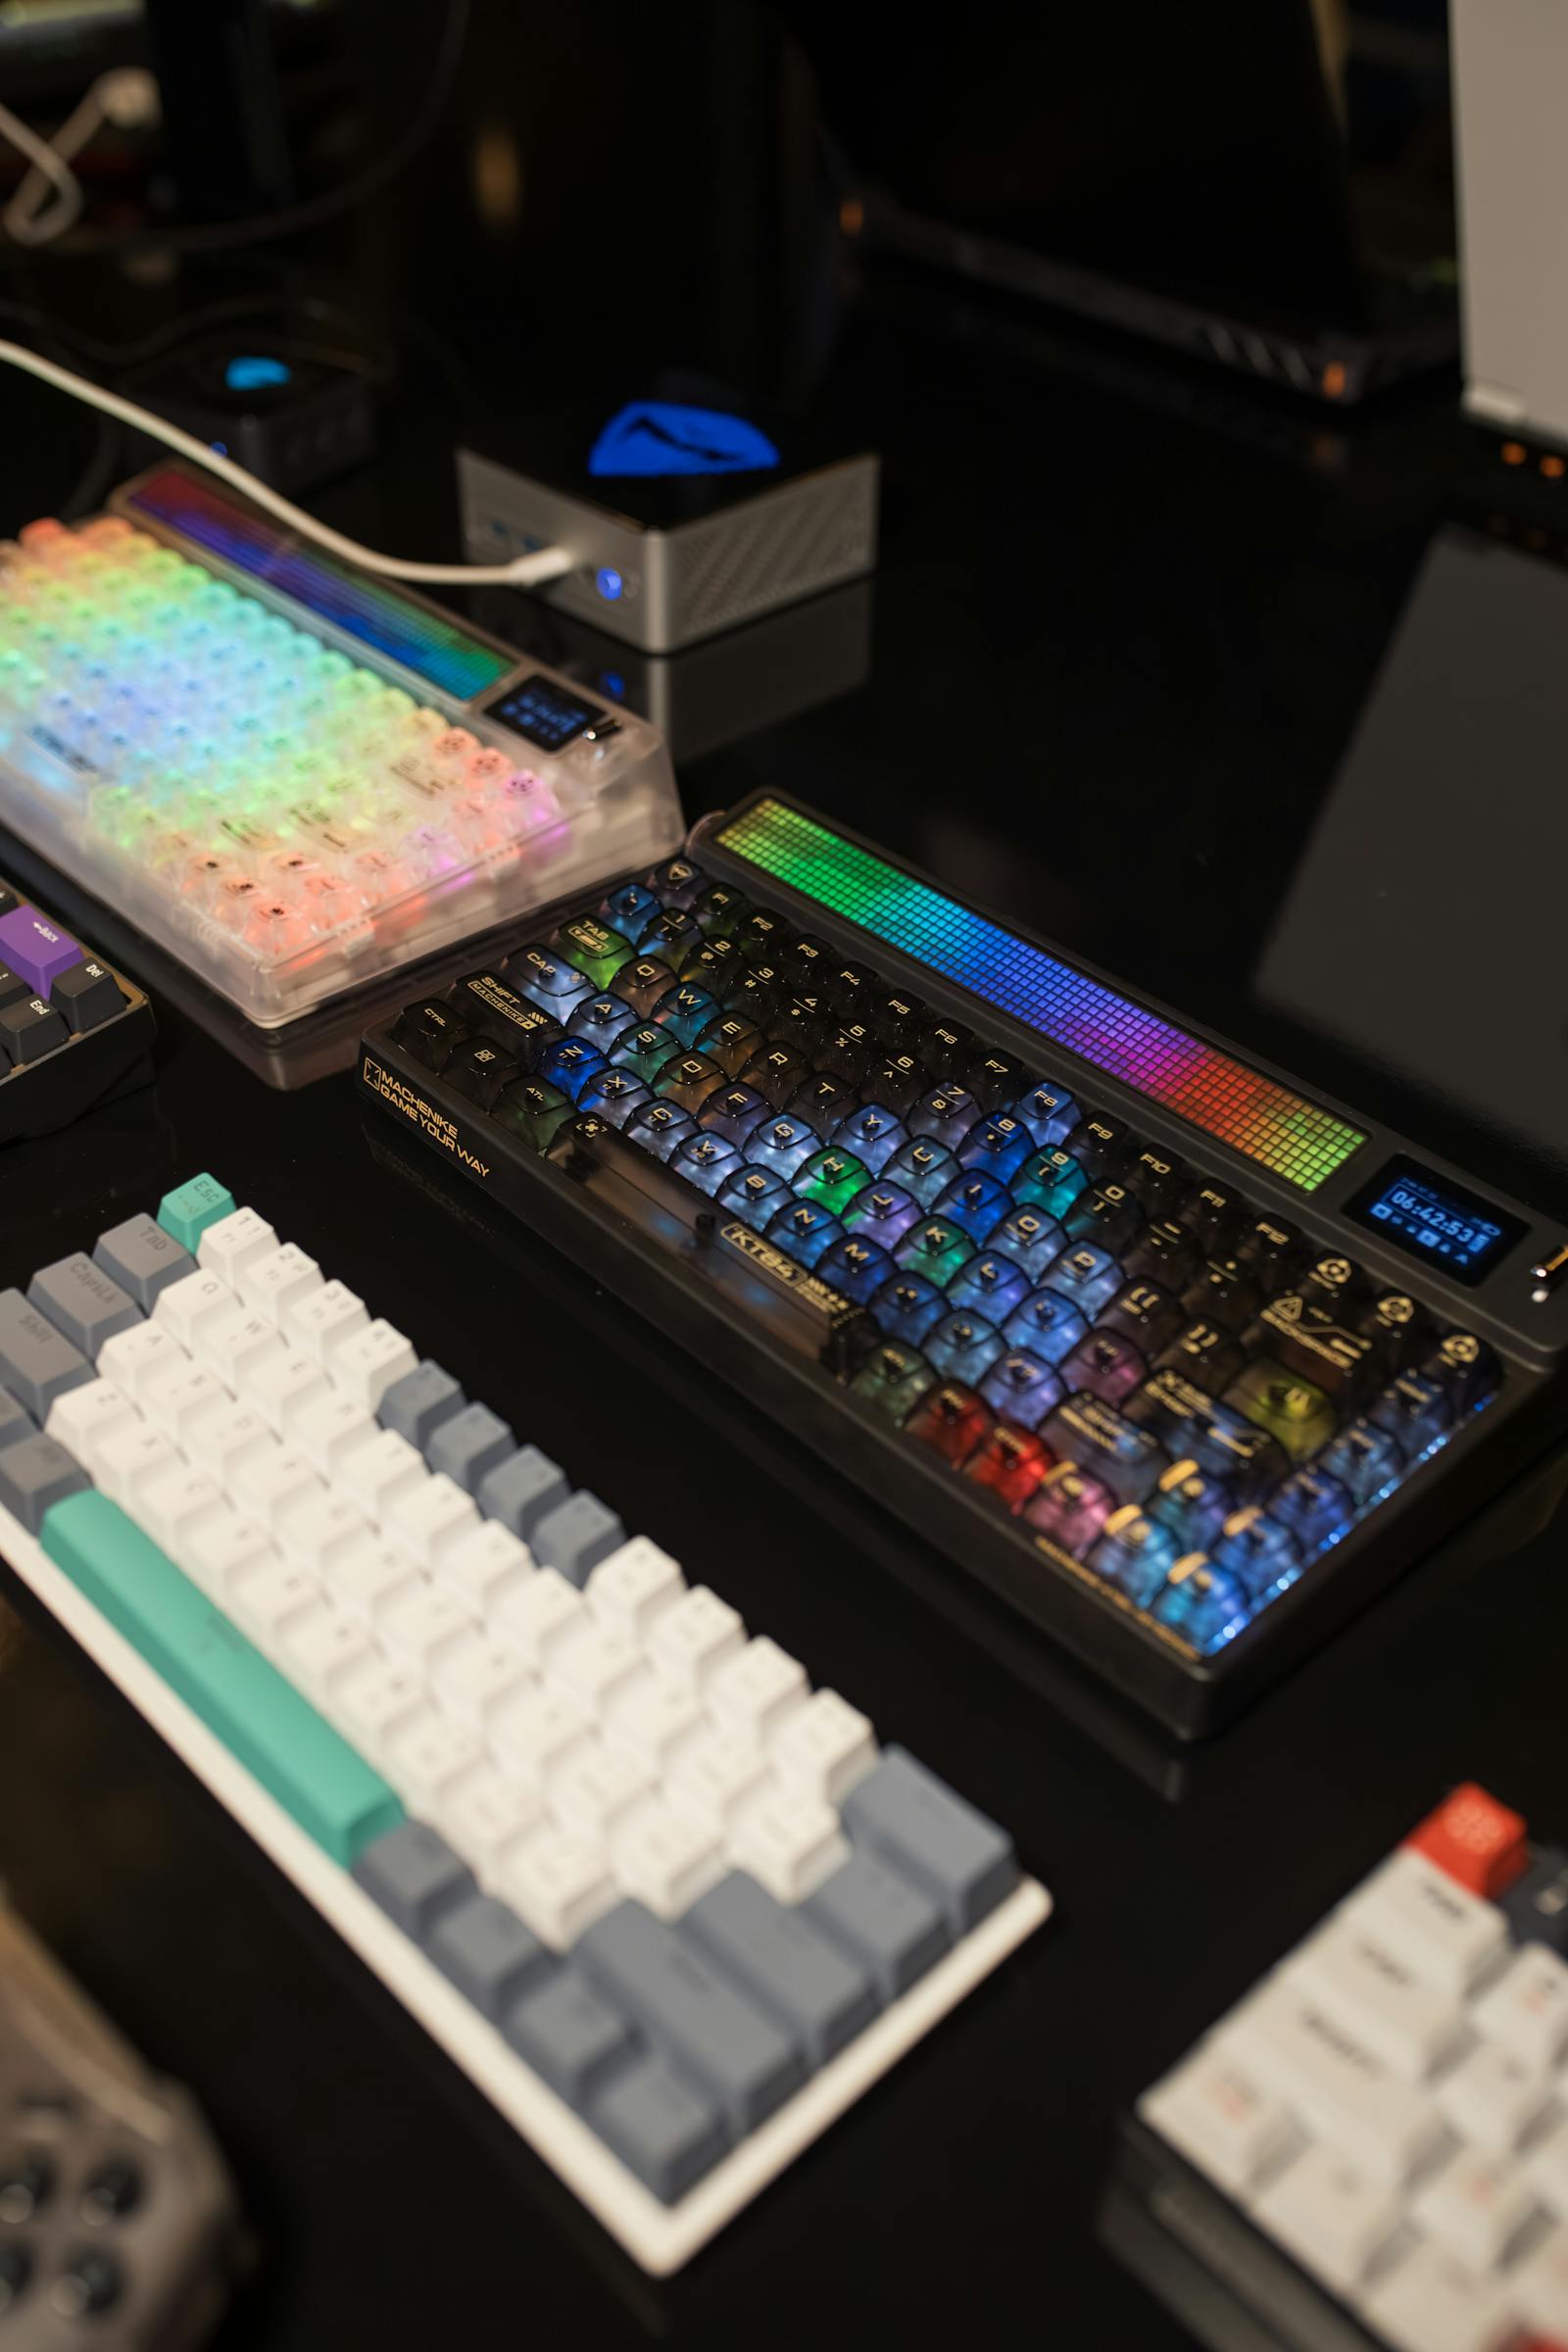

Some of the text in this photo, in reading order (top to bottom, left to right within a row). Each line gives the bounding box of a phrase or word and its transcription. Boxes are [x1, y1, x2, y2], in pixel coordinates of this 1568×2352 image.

[711, 893, 730, 905] F1
[675, 914, 686, 923] 1
[752, 916, 774, 931] F2
[582, 920, 610, 941] TAB
[714, 941, 731, 953] 2
[797, 944, 819, 958] F3
[85, 963, 104, 978] Del
[526, 953, 557, 974] CAP
[759, 967, 774, 979] 3
[840, 971, 861, 986] F4
[481, 976, 521, 1005] SHIFT
[678, 989, 702, 1005] W
[29, 999, 50, 1015] End
[472, 984, 525, 1024] MACHENIKE
[595, 1004, 612, 1014] A
[805, 998, 818, 1007] 4
[888, 1000, 910, 1014] F5
[424, 1007, 447, 1027] CTRL
[722, 1021, 742, 1035] E
[850, 1025, 866, 1037] 5
[638, 1031, 657, 1043] S
[934, 1028, 958, 1045] F6
[564, 1046, 584, 1057] Z
[682, 1059, 703, 1073] D
[768, 1052, 789, 1066] R
[897, 1056, 914, 1068] 6
[985, 1059, 1009, 1073] F7
[608, 1076, 628, 1089] X
[818, 1082, 835, 1094] T
[526, 1087, 544, 1102] ATL
[728, 1092, 748, 1103] F
[948, 1086, 965, 1096] 7
[382, 1070, 458, 1140] MACHENIKE
[1034, 1090, 1058, 1107] F8
[654, 1107, 672, 1121] C
[866, 1113, 884, 1126] Y
[380, 1084, 490, 1177] GAME YOUR WAY
[774, 1123, 795, 1138] G
[998, 1118, 1016, 1132] 8
[1088, 1122, 1114, 1141] F9
[702, 1140, 718, 1152] V
[913, 1147, 935, 1162] U
[1051, 1152, 1070, 1166] 9
[823, 1156, 845, 1171] H
[1140, 1152, 1172, 1175] F10
[746, 1174, 766, 1190] B
[969, 1184, 982, 1194] I
[794, 1208, 816, 1224] N
[1392, 1191, 1474, 1243] 06:42:53
[1018, 1215, 1041, 1232] O
[925, 1226, 949, 1244] K
[845, 1243, 870, 1261] M
